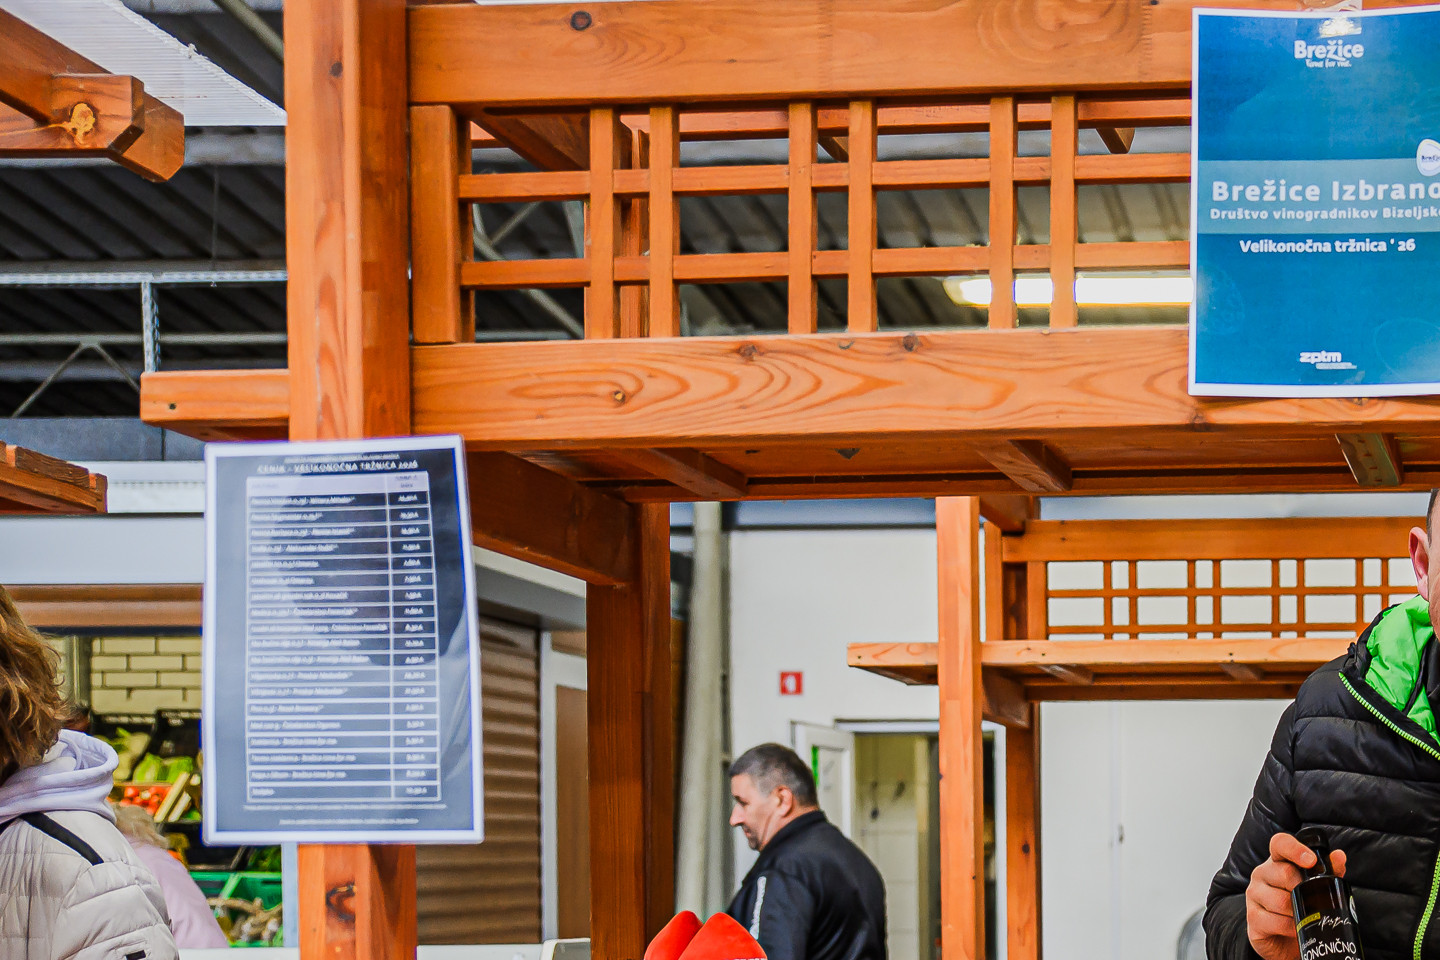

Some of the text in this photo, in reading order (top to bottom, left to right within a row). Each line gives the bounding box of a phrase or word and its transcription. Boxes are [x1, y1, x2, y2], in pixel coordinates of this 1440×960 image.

[1294, 39, 1364, 61] Brežice
[1212, 179, 1321, 202] Brežice
[1210, 208, 1268, 220] Društvo
[1273, 207, 1378, 222] vinogradnikov
[1239, 239, 1332, 253] Velikonočna
[1334, 238, 1387, 252] tržnica
